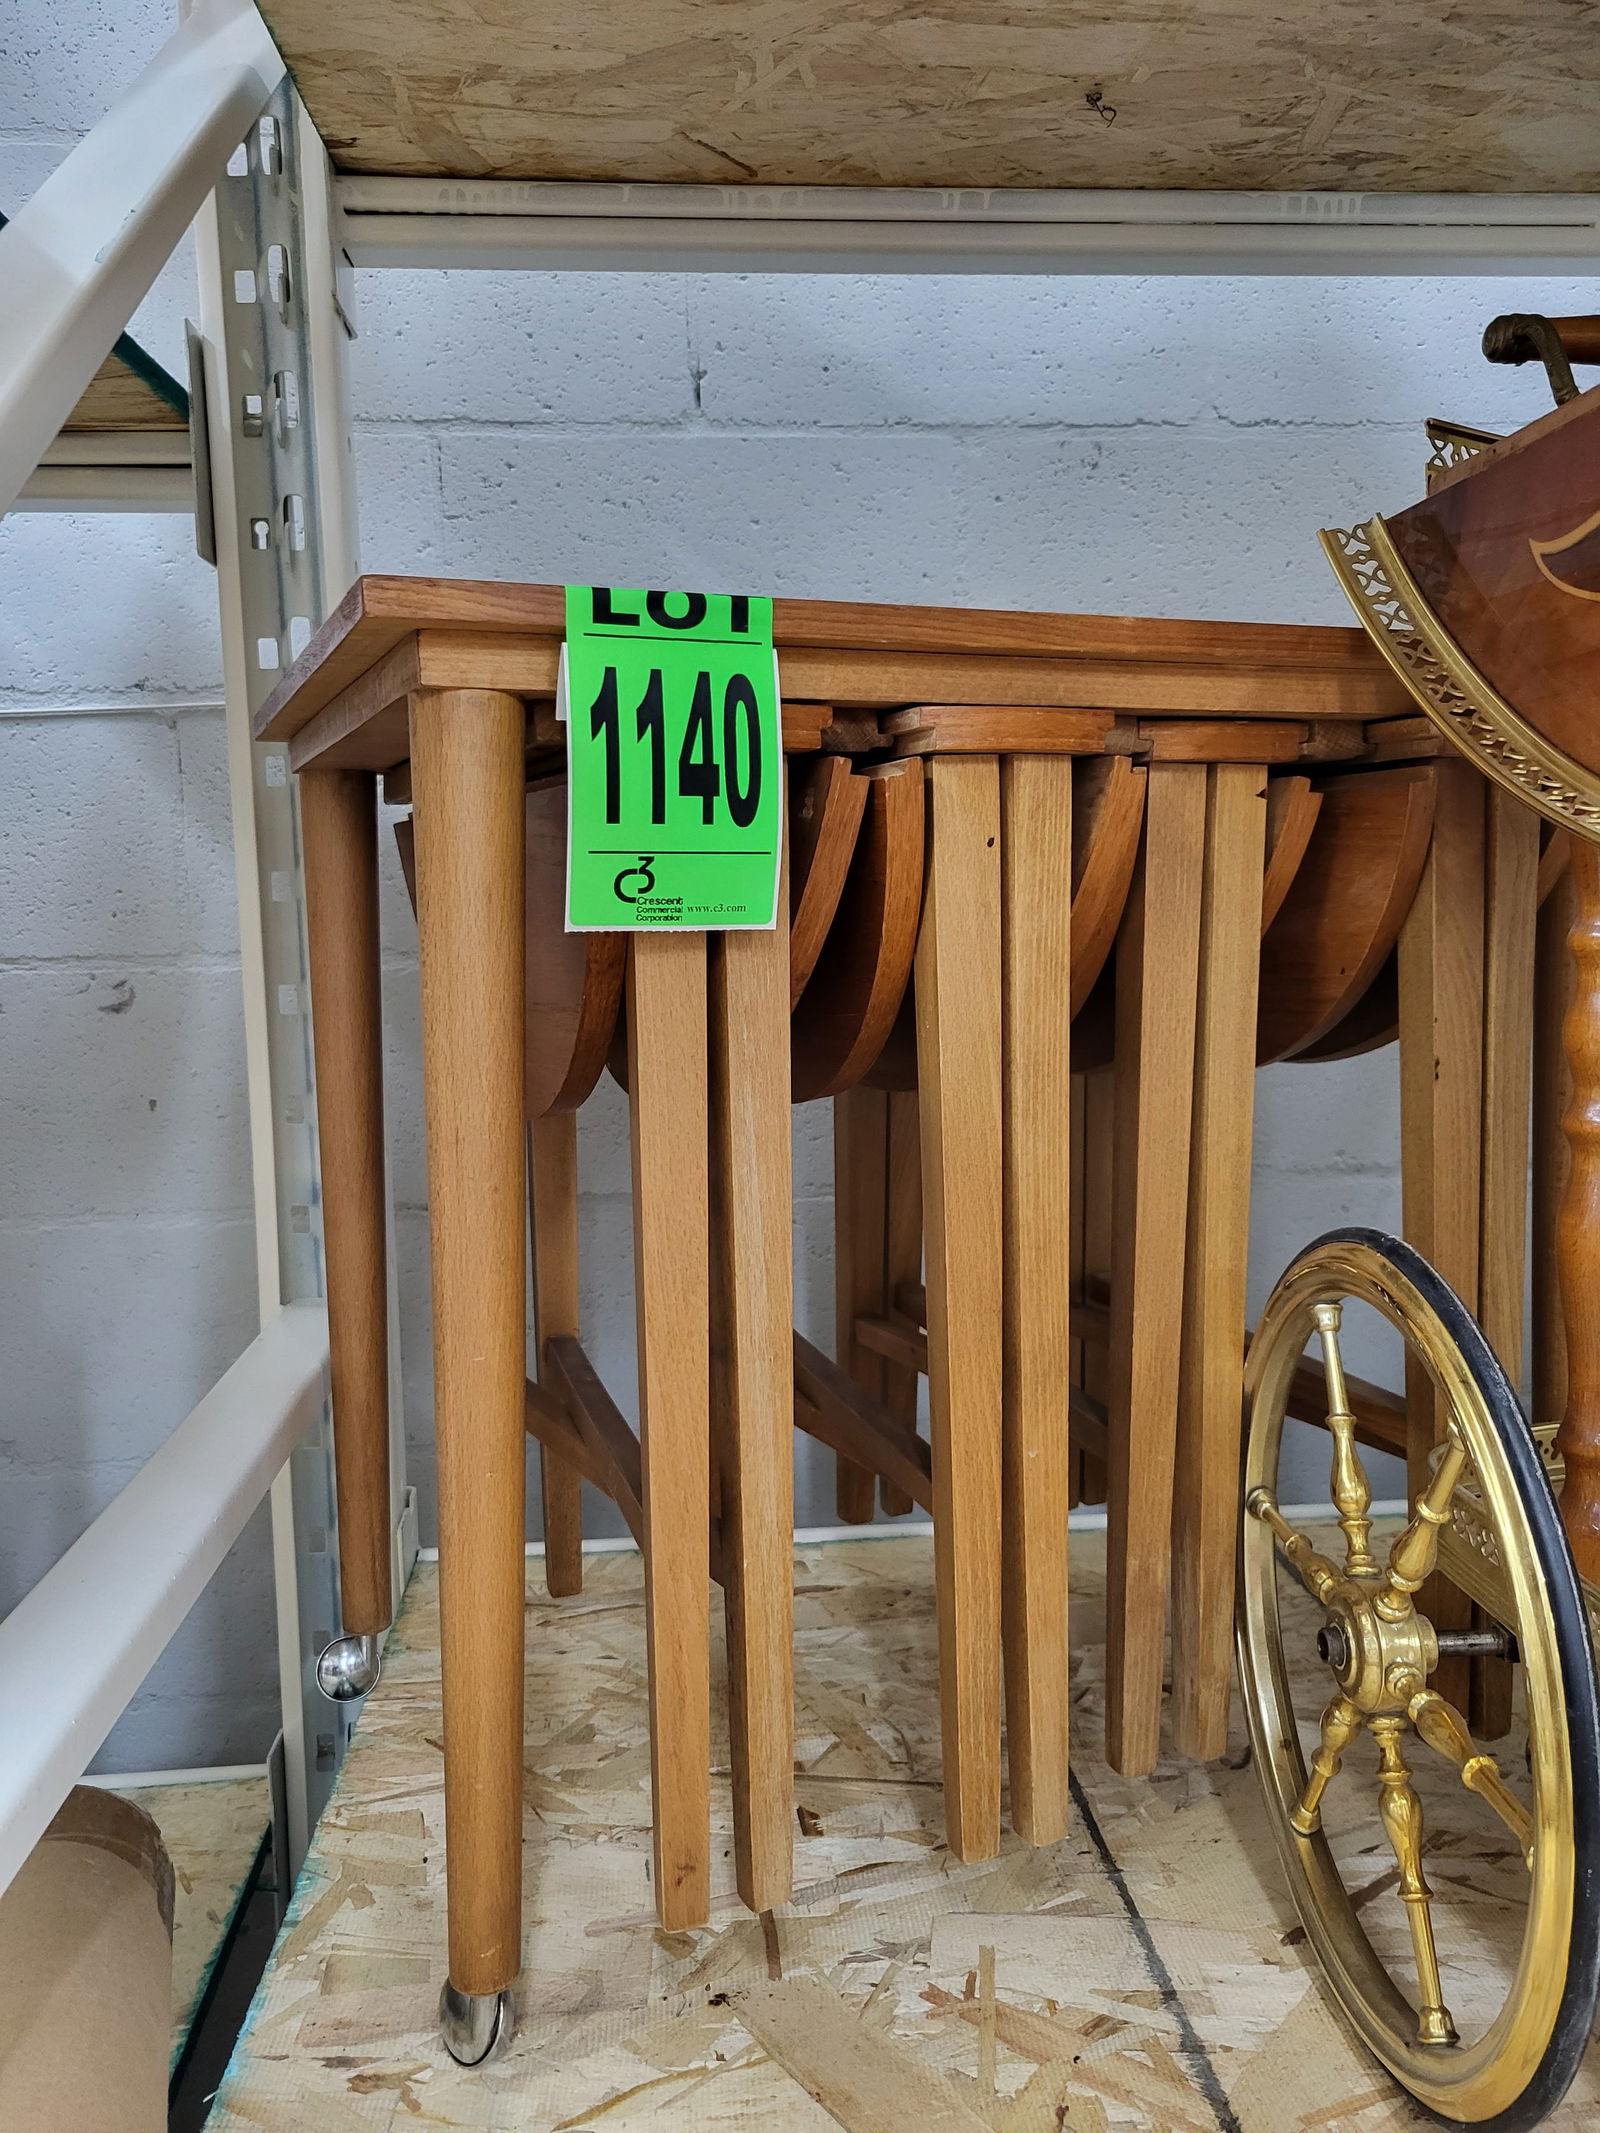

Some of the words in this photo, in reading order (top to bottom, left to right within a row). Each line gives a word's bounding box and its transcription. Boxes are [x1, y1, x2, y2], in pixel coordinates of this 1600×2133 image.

[590, 666, 762, 828] 1140
[637, 897, 683, 906] Crescent
[636, 906, 684, 914] Commercial
[687, 904, 747, 913] www.c3.com
[636, 914, 683, 923] Corporation
